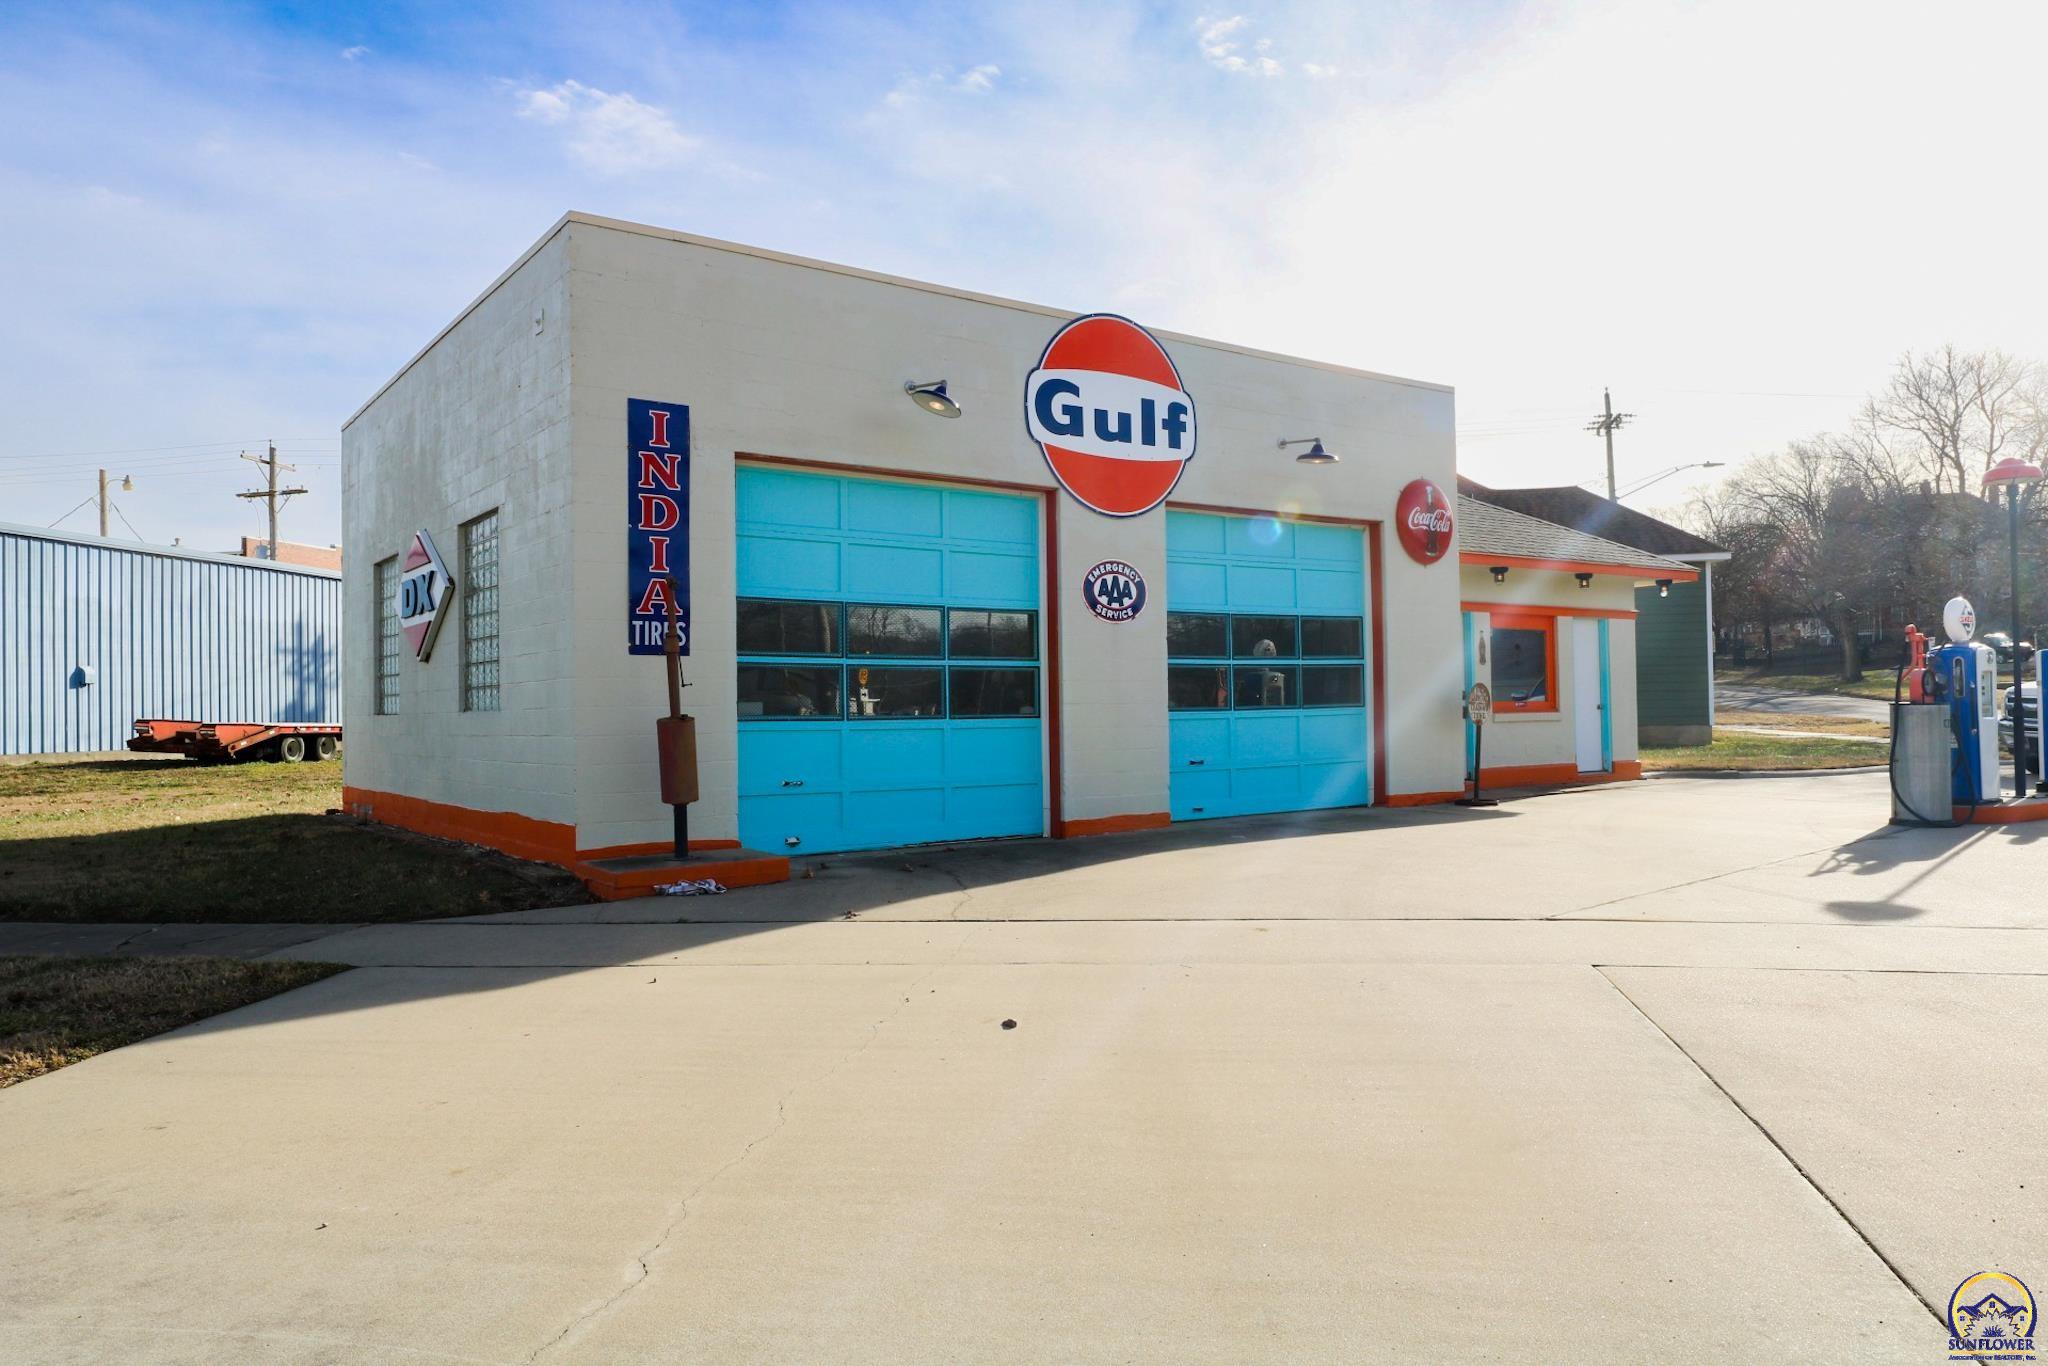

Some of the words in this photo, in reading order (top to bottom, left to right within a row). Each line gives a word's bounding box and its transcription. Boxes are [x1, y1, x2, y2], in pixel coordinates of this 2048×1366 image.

[1034, 378, 1188, 449] Gulf
[636, 410, 683, 616] INDIA
[1408, 506, 1451, 533] Coca-Cola
[1088, 563, 1140, 583] EMERGENCY
[1097, 575, 1133, 606] AAA
[1095, 604, 1134, 619] SERVICE
